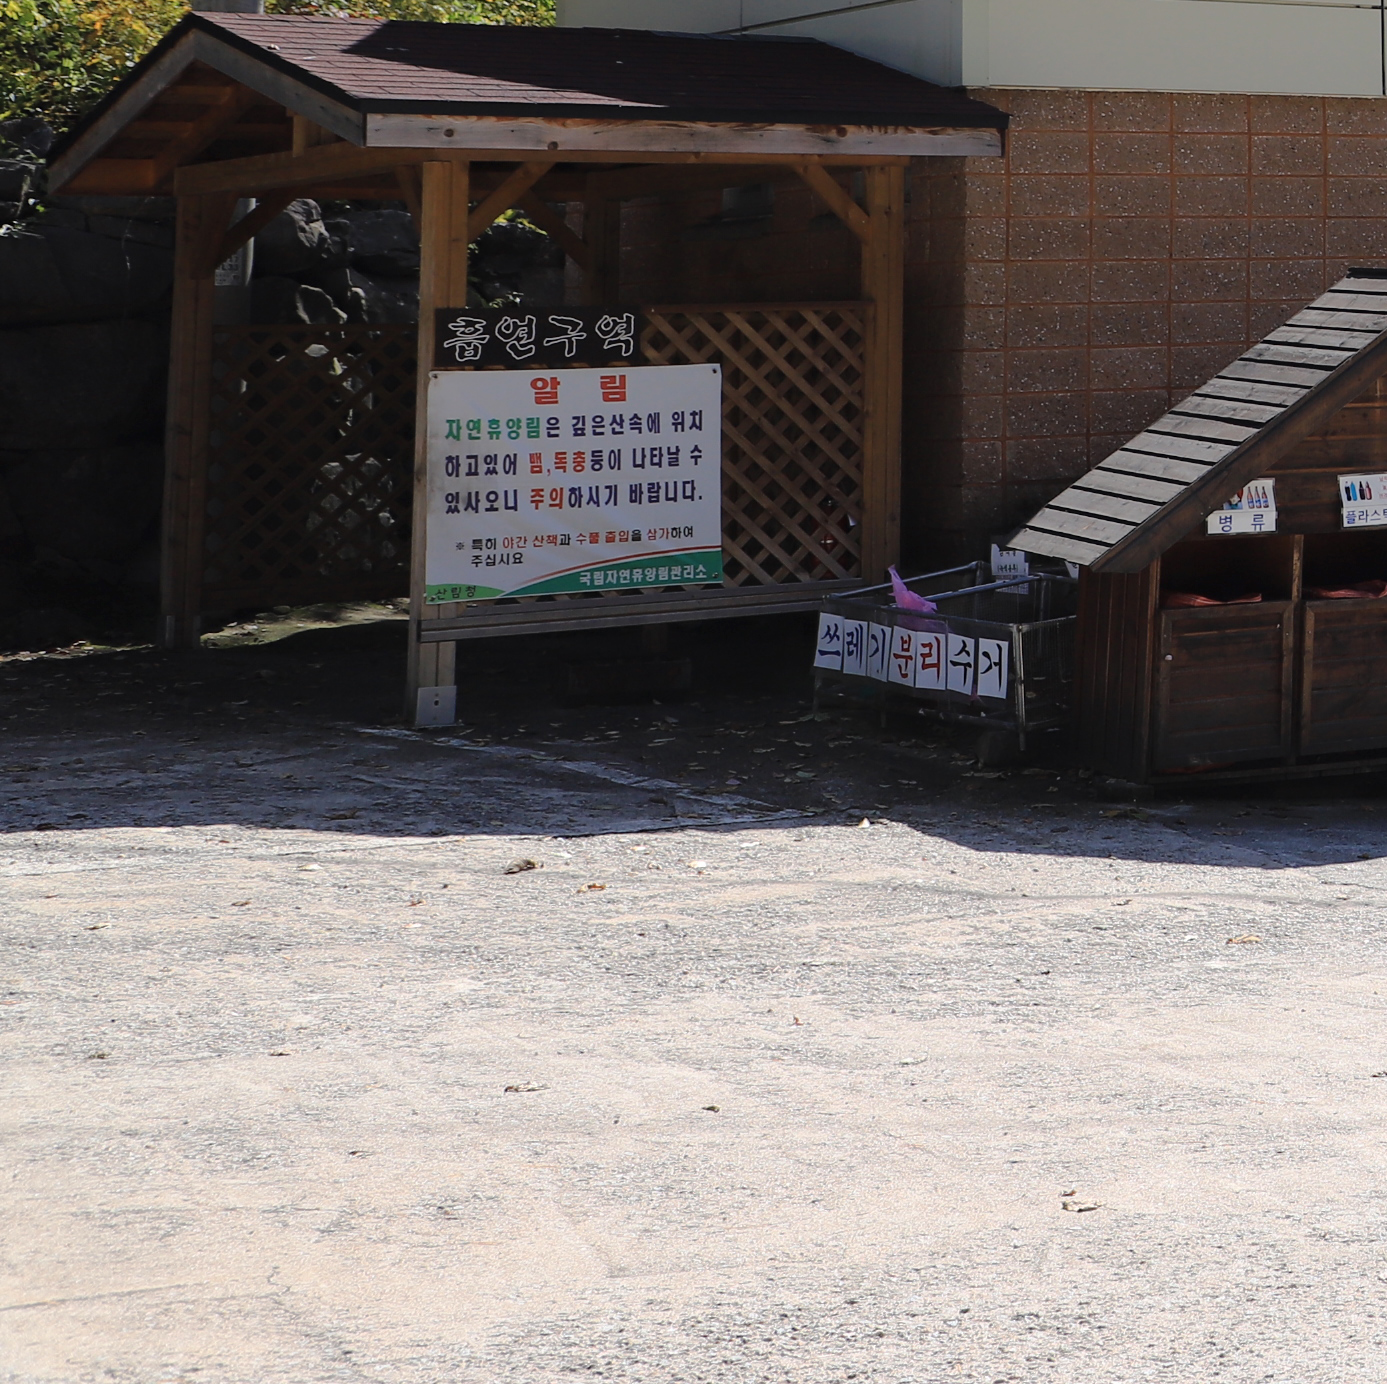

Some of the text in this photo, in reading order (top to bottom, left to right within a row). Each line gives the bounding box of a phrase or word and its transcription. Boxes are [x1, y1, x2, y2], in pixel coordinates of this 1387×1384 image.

[443, 313, 634, 362] 흡연구역
[445, 410, 703, 441] 자연휴양림은 깊은산속에 위치
[445, 444, 703, 478] 하고있어 뱀,독충등이 나타날 수
[445, 480, 703, 515] 있사오니 주의하시기 바랍니다.
[471, 538, 498, 552] 특히
[502, 535, 528, 549] 야간
[532, 533, 571, 548] 산책과
[576, 531, 601, 545] 수풀
[604, 529, 642, 543] 출입을
[646, 526, 694, 541] 삼가하여
[471, 552, 524, 567] 주십시요
[579, 564, 708, 586] 국립자연휴양림관리소
[434, 585, 477, 601] 산림청
